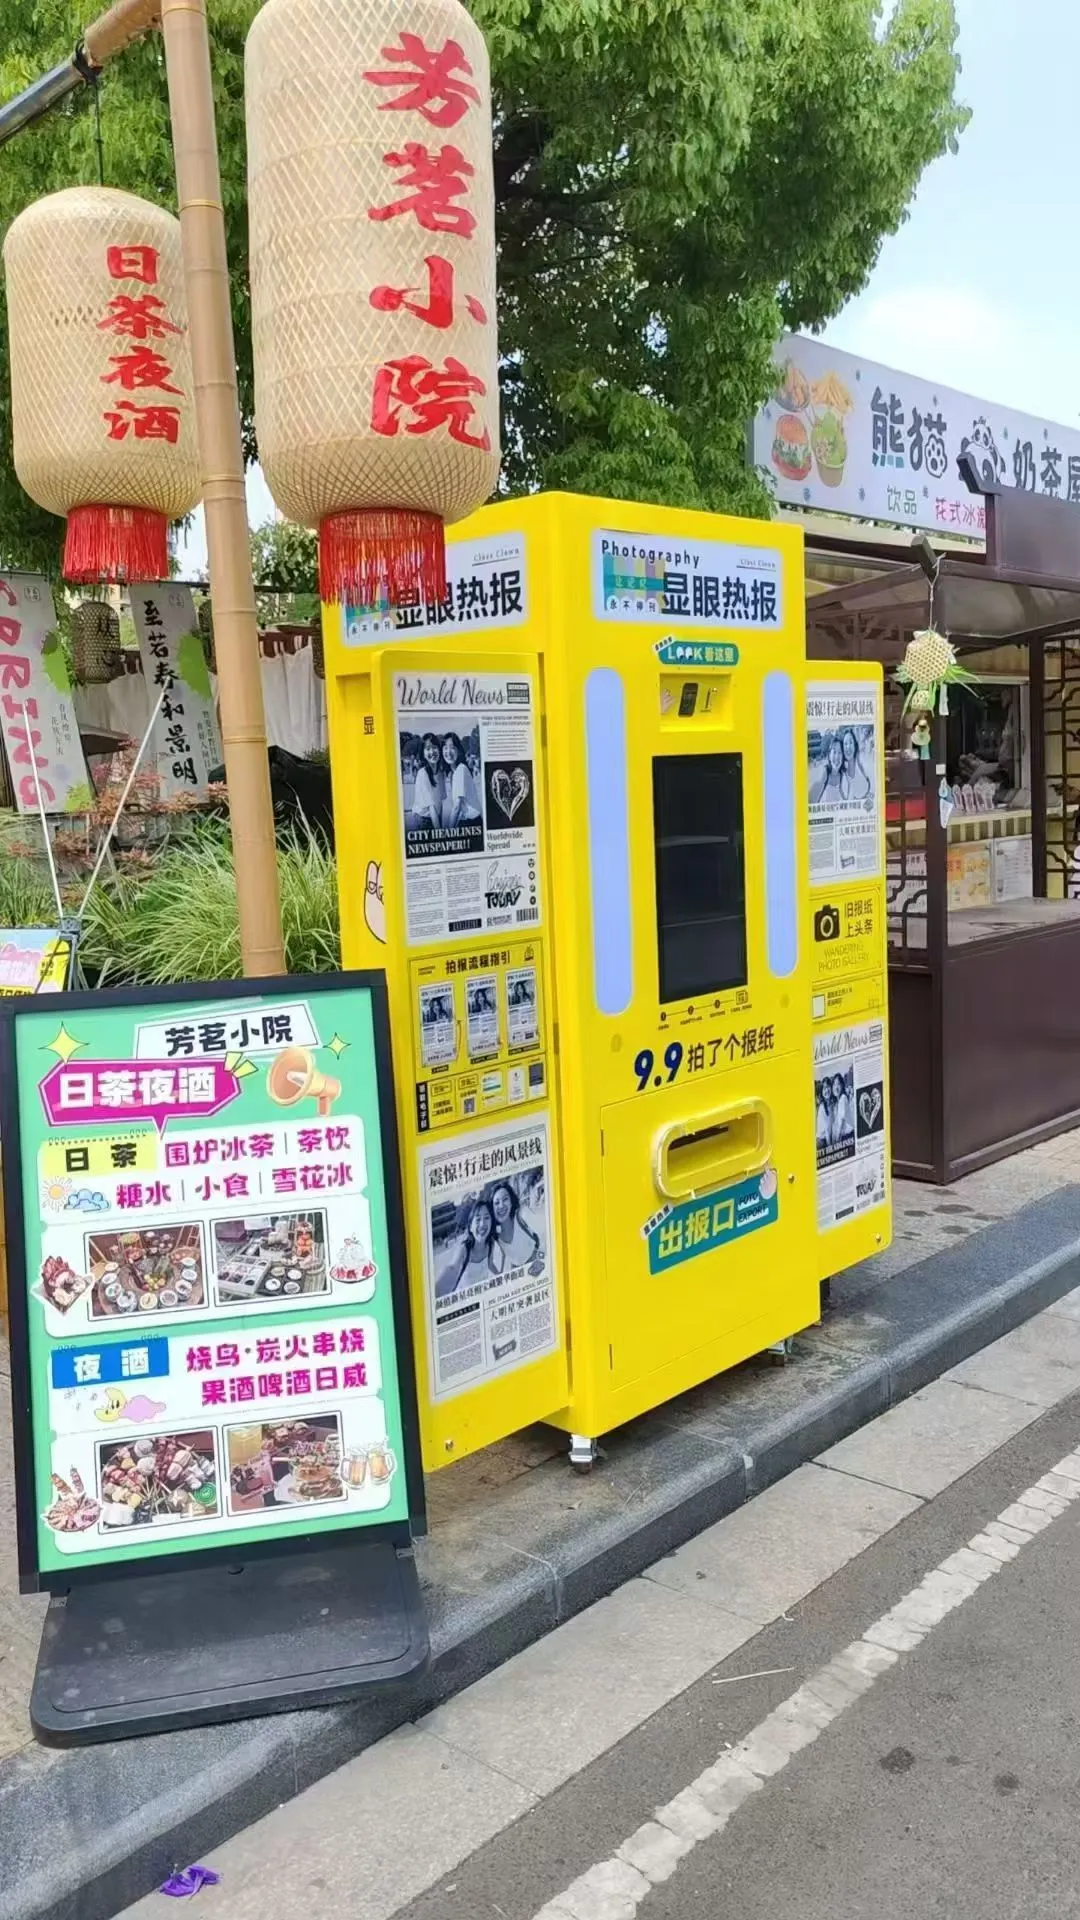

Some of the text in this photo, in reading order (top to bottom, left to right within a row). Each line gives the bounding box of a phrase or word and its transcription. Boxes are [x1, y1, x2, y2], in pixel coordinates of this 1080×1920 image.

[363, 32, 491, 451] 芳茗小院
[96, 245, 186, 444] 日茶夜酒
[870, 386, 947, 479] 熊猫
[887, 484, 917, 516] 饮品
[601, 540, 700, 569] Photography
[661, 572, 778, 622] 显眼热报
[143, 600, 198, 785] 至若春和景明
[397, 677, 457, 706] World
[461, 677, 504, 706] News
[407, 825, 482, 841] CITY HEADLINES
[408, 839, 471, 855] NEWSPAPER!!
[164, 1014, 293, 1058] 芳茗小院
[634, 1024, 775, 1091] 9.9 拍了个报纸
[59, 1066, 216, 1109] 日茶夜酒
[164, 1133, 275, 1168] 围炉冰茶
[428, 1136, 542, 1188] 震惊!行走的风景线
[116, 1162, 353, 1210] 糖水 小食 雪花冰
[658, 1198, 735, 1259] 出报口
